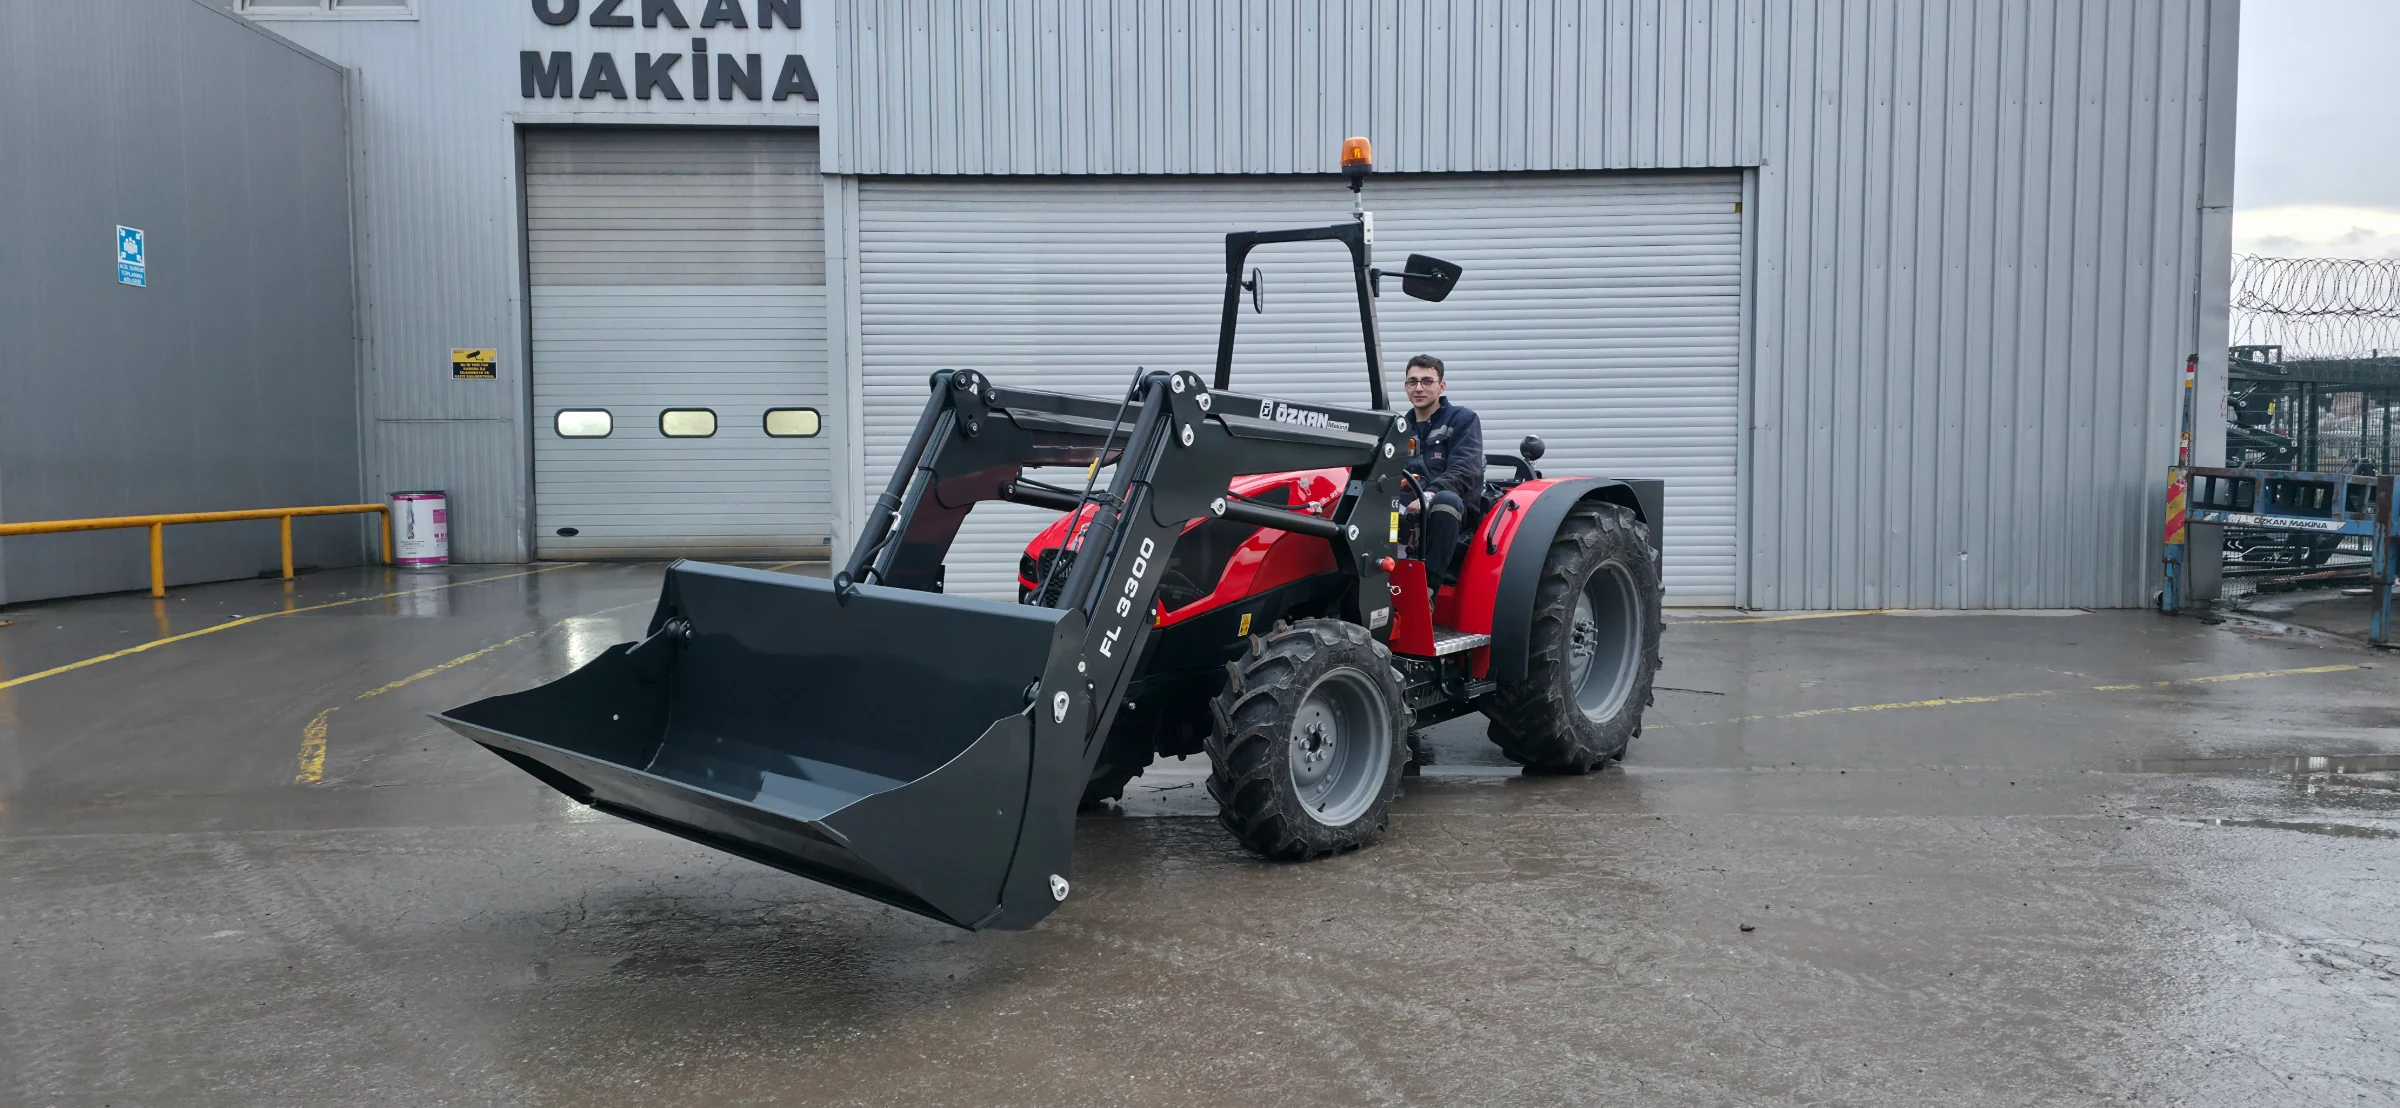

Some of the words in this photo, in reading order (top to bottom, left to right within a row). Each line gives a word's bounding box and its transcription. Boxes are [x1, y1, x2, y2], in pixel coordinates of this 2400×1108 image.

[520, 37, 819, 101] MAKİNA
[1276, 403, 1328, 429] ÖZKAN
[1100, 626, 1121, 658] FL
[1116, 537, 1155, 617] 3300
